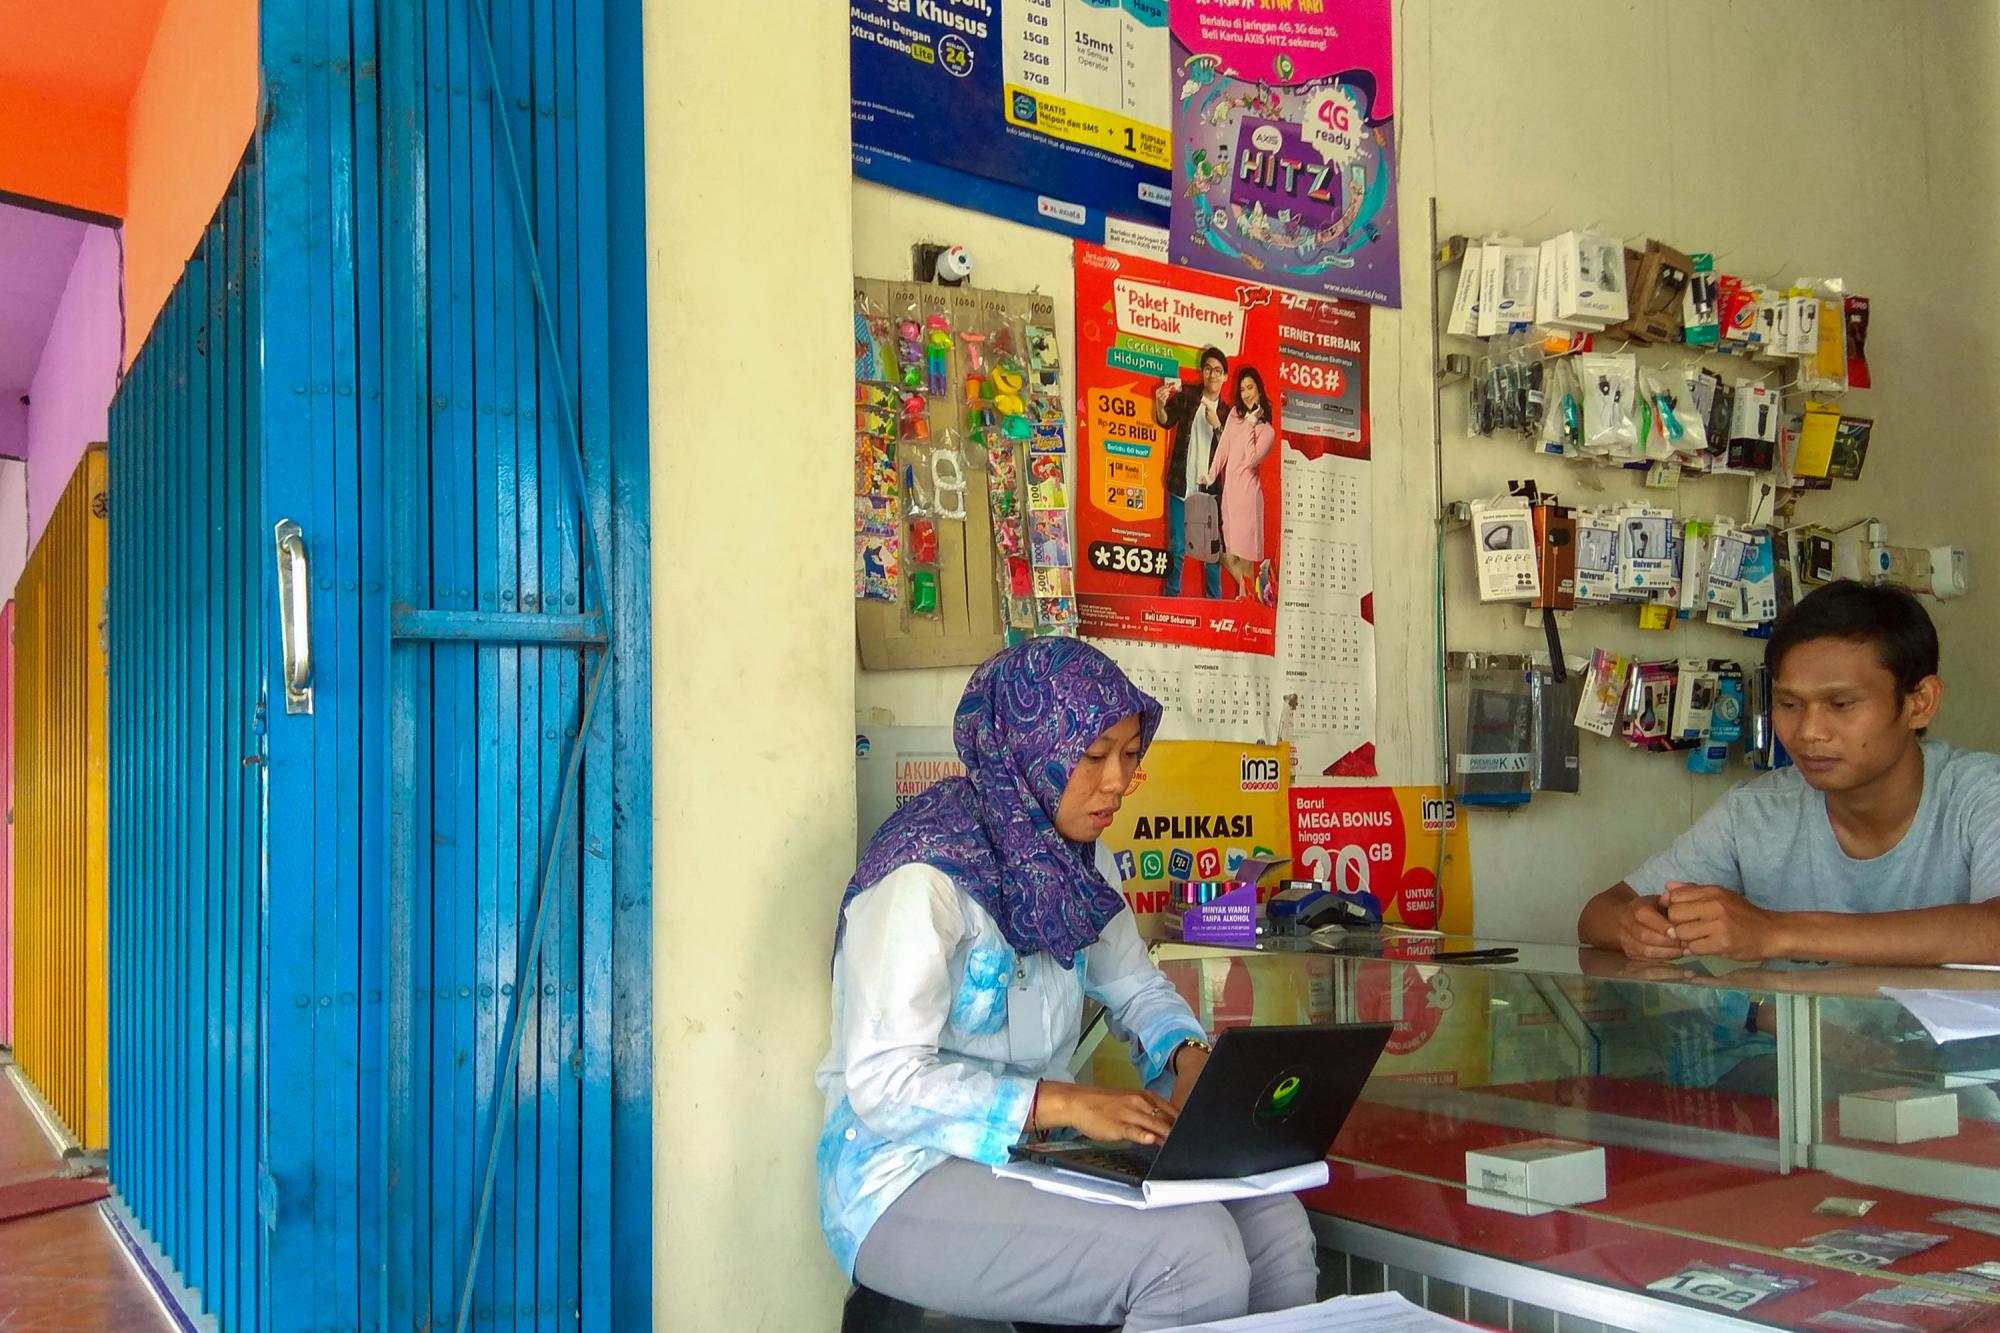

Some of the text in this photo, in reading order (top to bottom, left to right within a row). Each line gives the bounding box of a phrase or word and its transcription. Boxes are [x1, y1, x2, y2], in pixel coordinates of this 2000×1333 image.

[1133, 0, 1162, 17] Harga
[850, 6, 931, 43] Mudah! Dengan
[915, 0, 988, 38] Khusus
[1027, 12, 1048, 27] 8GB
[1199, 14, 1232, 28] Berlaku
[1233, 18, 1241, 28] di
[1243, 19, 1277, 34] jaringan
[1295, 23, 1306, 34] 3G
[1307, 25, 1323, 35] dan
[850, 24, 933, 60] Xtra Combo Lite
[1023, 30, 1050, 46] 15GB
[1075, 31, 1114, 55] 15mnt
[1201, 28, 1328, 52] Beli Kartu AXIS HITZ sekarang!
[945, 47, 967, 66] 24
[1023, 50, 1050, 66] 25GB
[1023, 70, 1050, 86] 37GB
[1038, 102, 1067, 116] GRATIS
[1318, 99, 1349, 132] 4G
[1082, 122, 1099, 133] SMS
[1124, 128, 1137, 152] 1
[1140, 133, 1167, 147] RUPIAH
[1255, 132, 1279, 145] AXIS
[1315, 129, 1352, 149] ready
[1239, 149, 1335, 202] HITZ
[924, 294, 946, 306] 1000
[955, 296, 975, 308] 1000
[985, 301, 1006, 313] 1000
[1031, 303, 1053, 315] 1000
[1173, 299, 1234, 327] Internet
[1128, 309, 1181, 334] Terbaik
[1126, 337, 1175, 358] Ceriakan
[1316, 333, 1361, 353] TERBAIK
[1114, 352, 1164, 372] Hidupmu
[1098, 394, 1136, 417] 3GB
[1098, 418, 1108, 428] Rp
[1108, 422, 1126, 437] 25
[1129, 425, 1157, 442] RIBU
[1109, 462, 1114, 477] 1
[1108, 487, 1116, 503] 2
[1209, 618, 1235, 633] 4G
[895, 761, 960, 779] LAKUKAN
[1242, 754, 1279, 780] im3
[1296, 797, 1324, 810] Baru!
[1133, 815, 1253, 840] APLIKASI
[1297, 811, 1393, 828] MEGA BONUS
[1298, 831, 1331, 845] hingga
[1369, 843, 1393, 861] GB
[1405, 888, 1434, 899] UNTUK
[1202, 905, 1250, 914] MINYAK WANGI
[1406, 901, 1435, 911] SEMUA
[1202, 914, 1250, 923] TANPA ALKOHOL
[1671, 1275, 1757, 1305] 1GB
